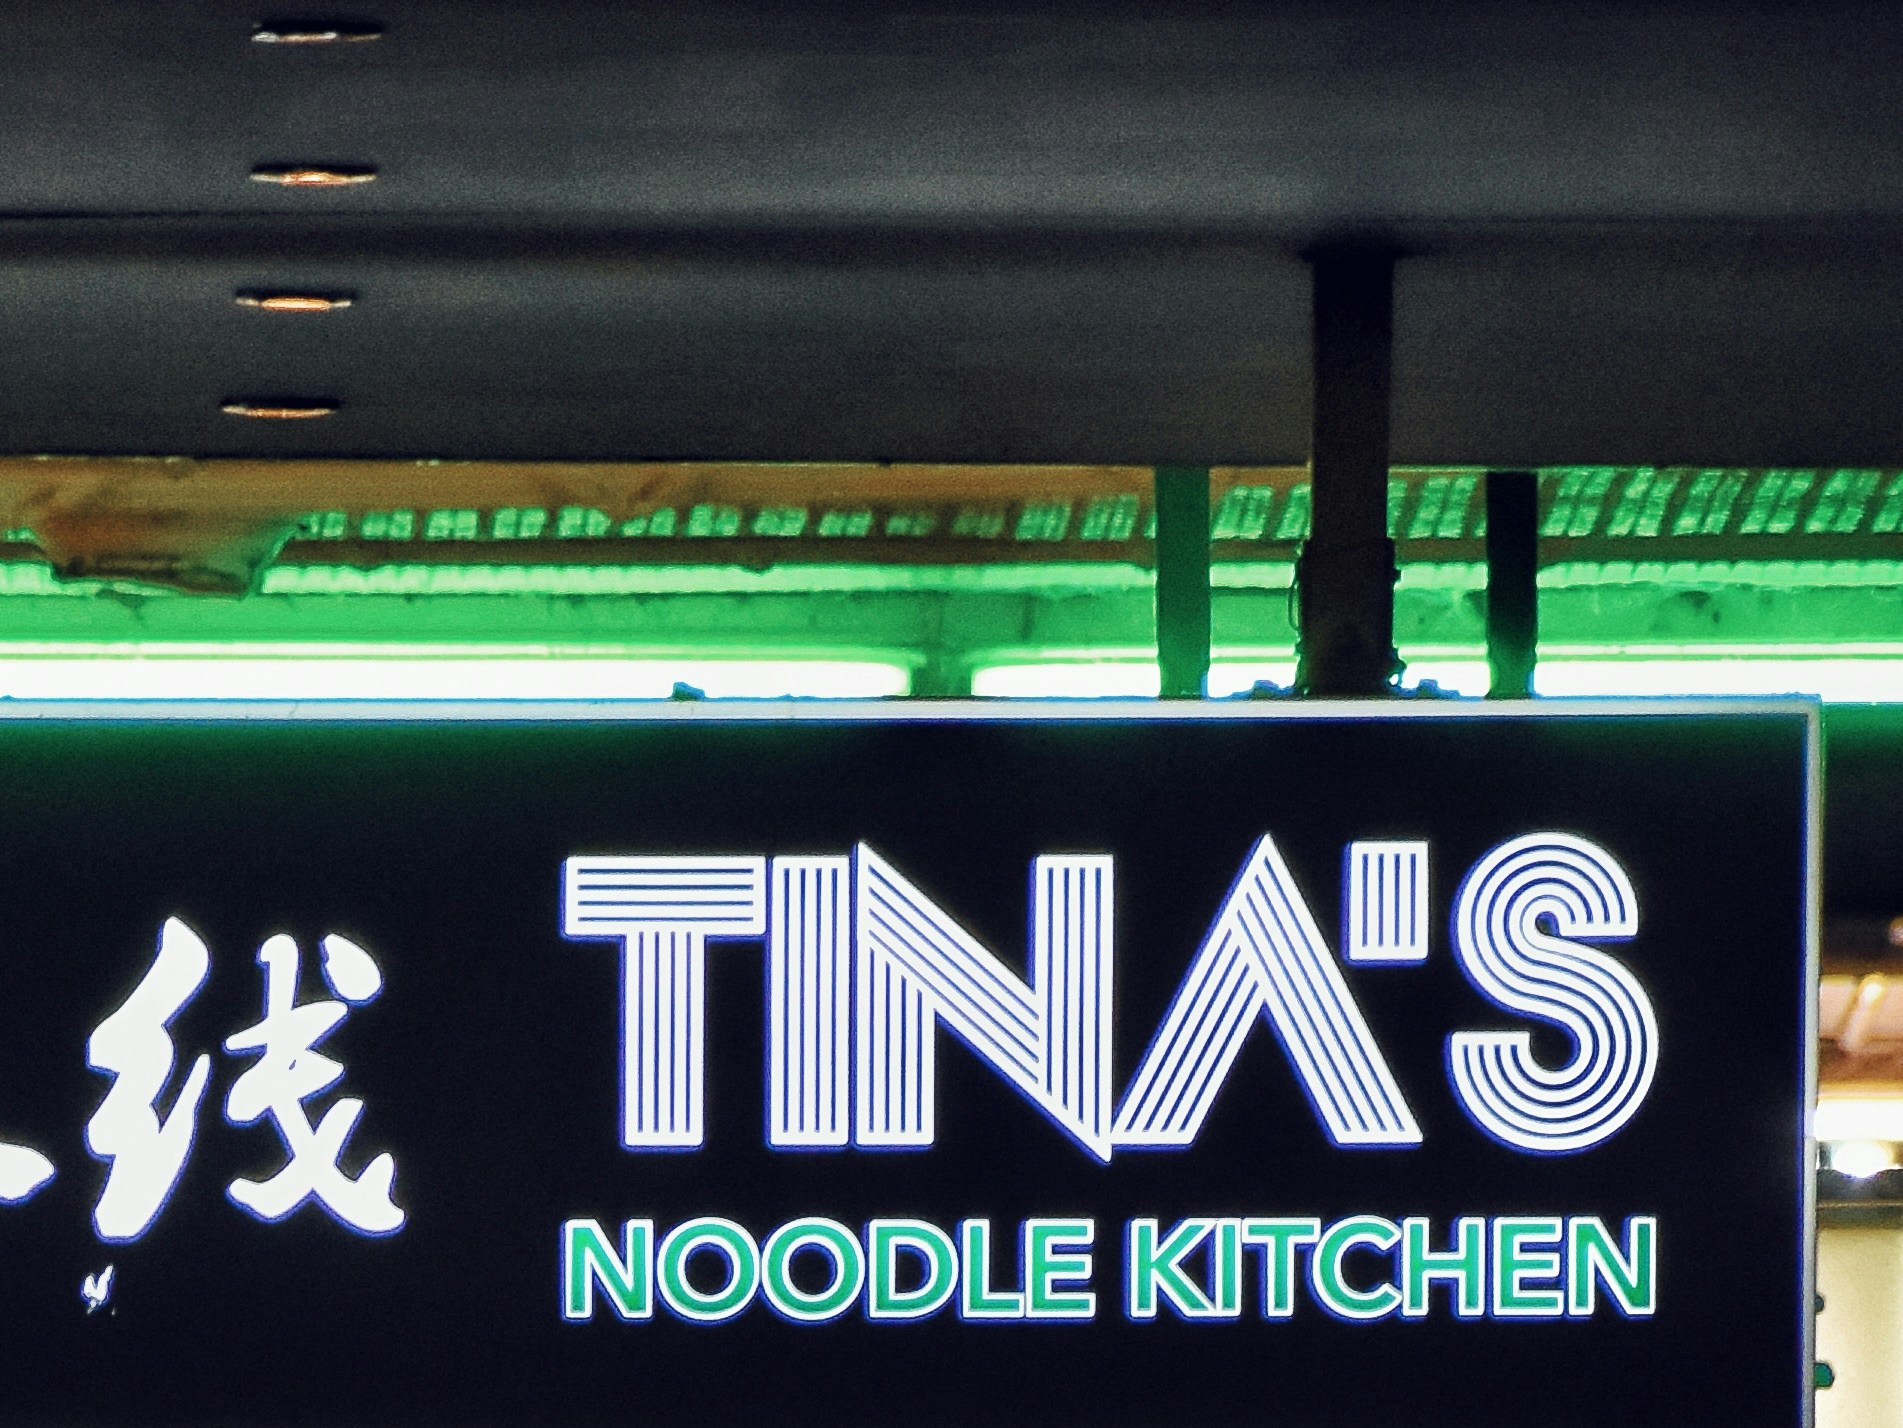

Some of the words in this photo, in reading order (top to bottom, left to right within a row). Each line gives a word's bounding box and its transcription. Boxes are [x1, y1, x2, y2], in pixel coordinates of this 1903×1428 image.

[562, 829, 1660, 1162] TINA'S
[562, 1217, 1096, 1320] NOODLE
[1127, 1215, 1657, 1318] KITCHEN
